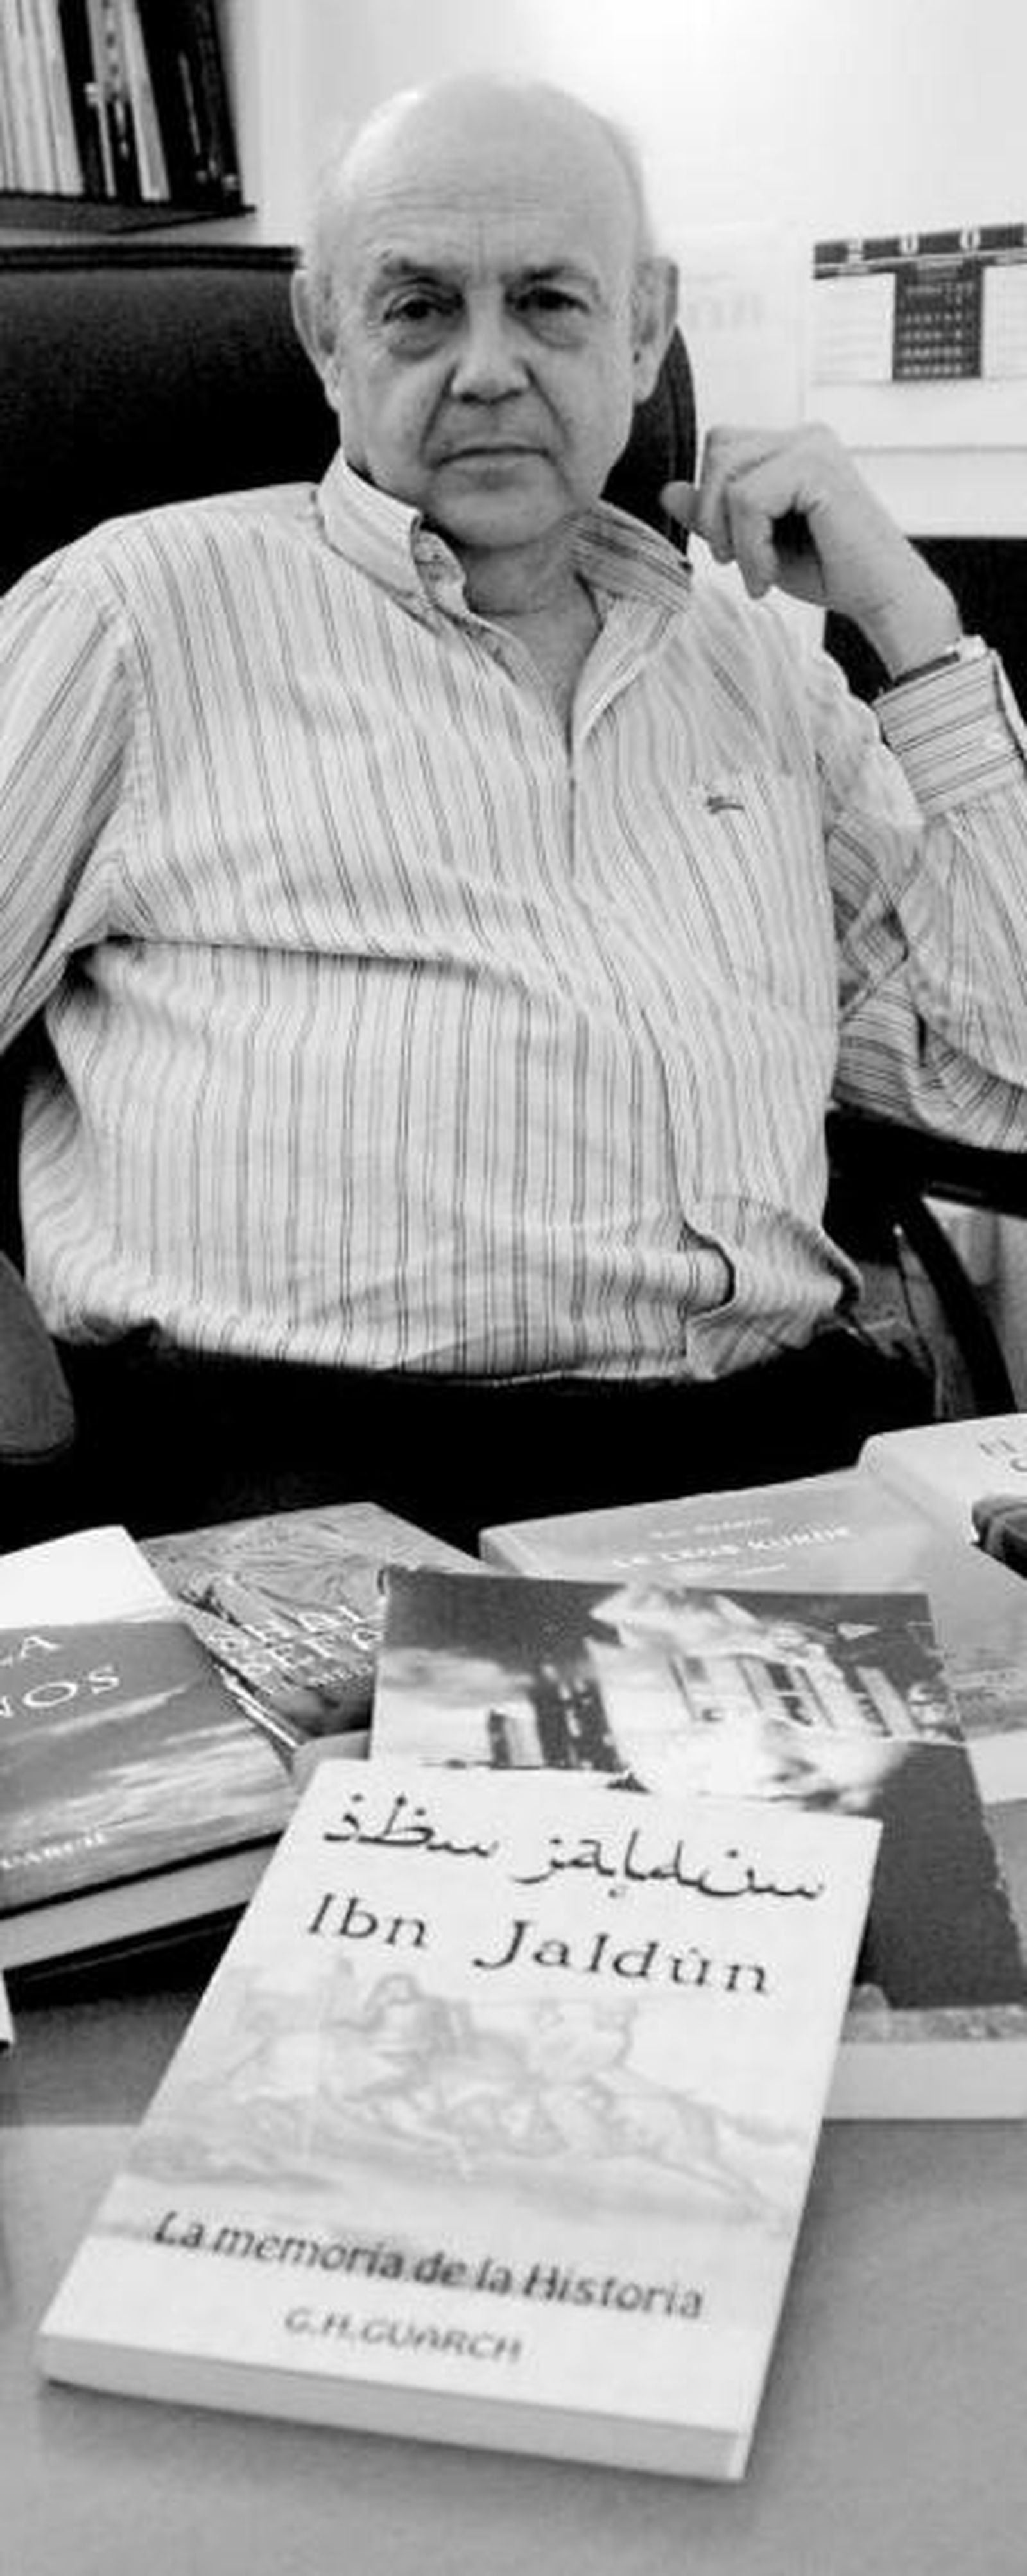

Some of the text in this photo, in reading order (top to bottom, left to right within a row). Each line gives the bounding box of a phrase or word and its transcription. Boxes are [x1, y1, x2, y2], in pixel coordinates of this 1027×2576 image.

[308, 1893, 427, 1948] Ibn
[153, 2210, 703, 2319] La memoria de la Historia
